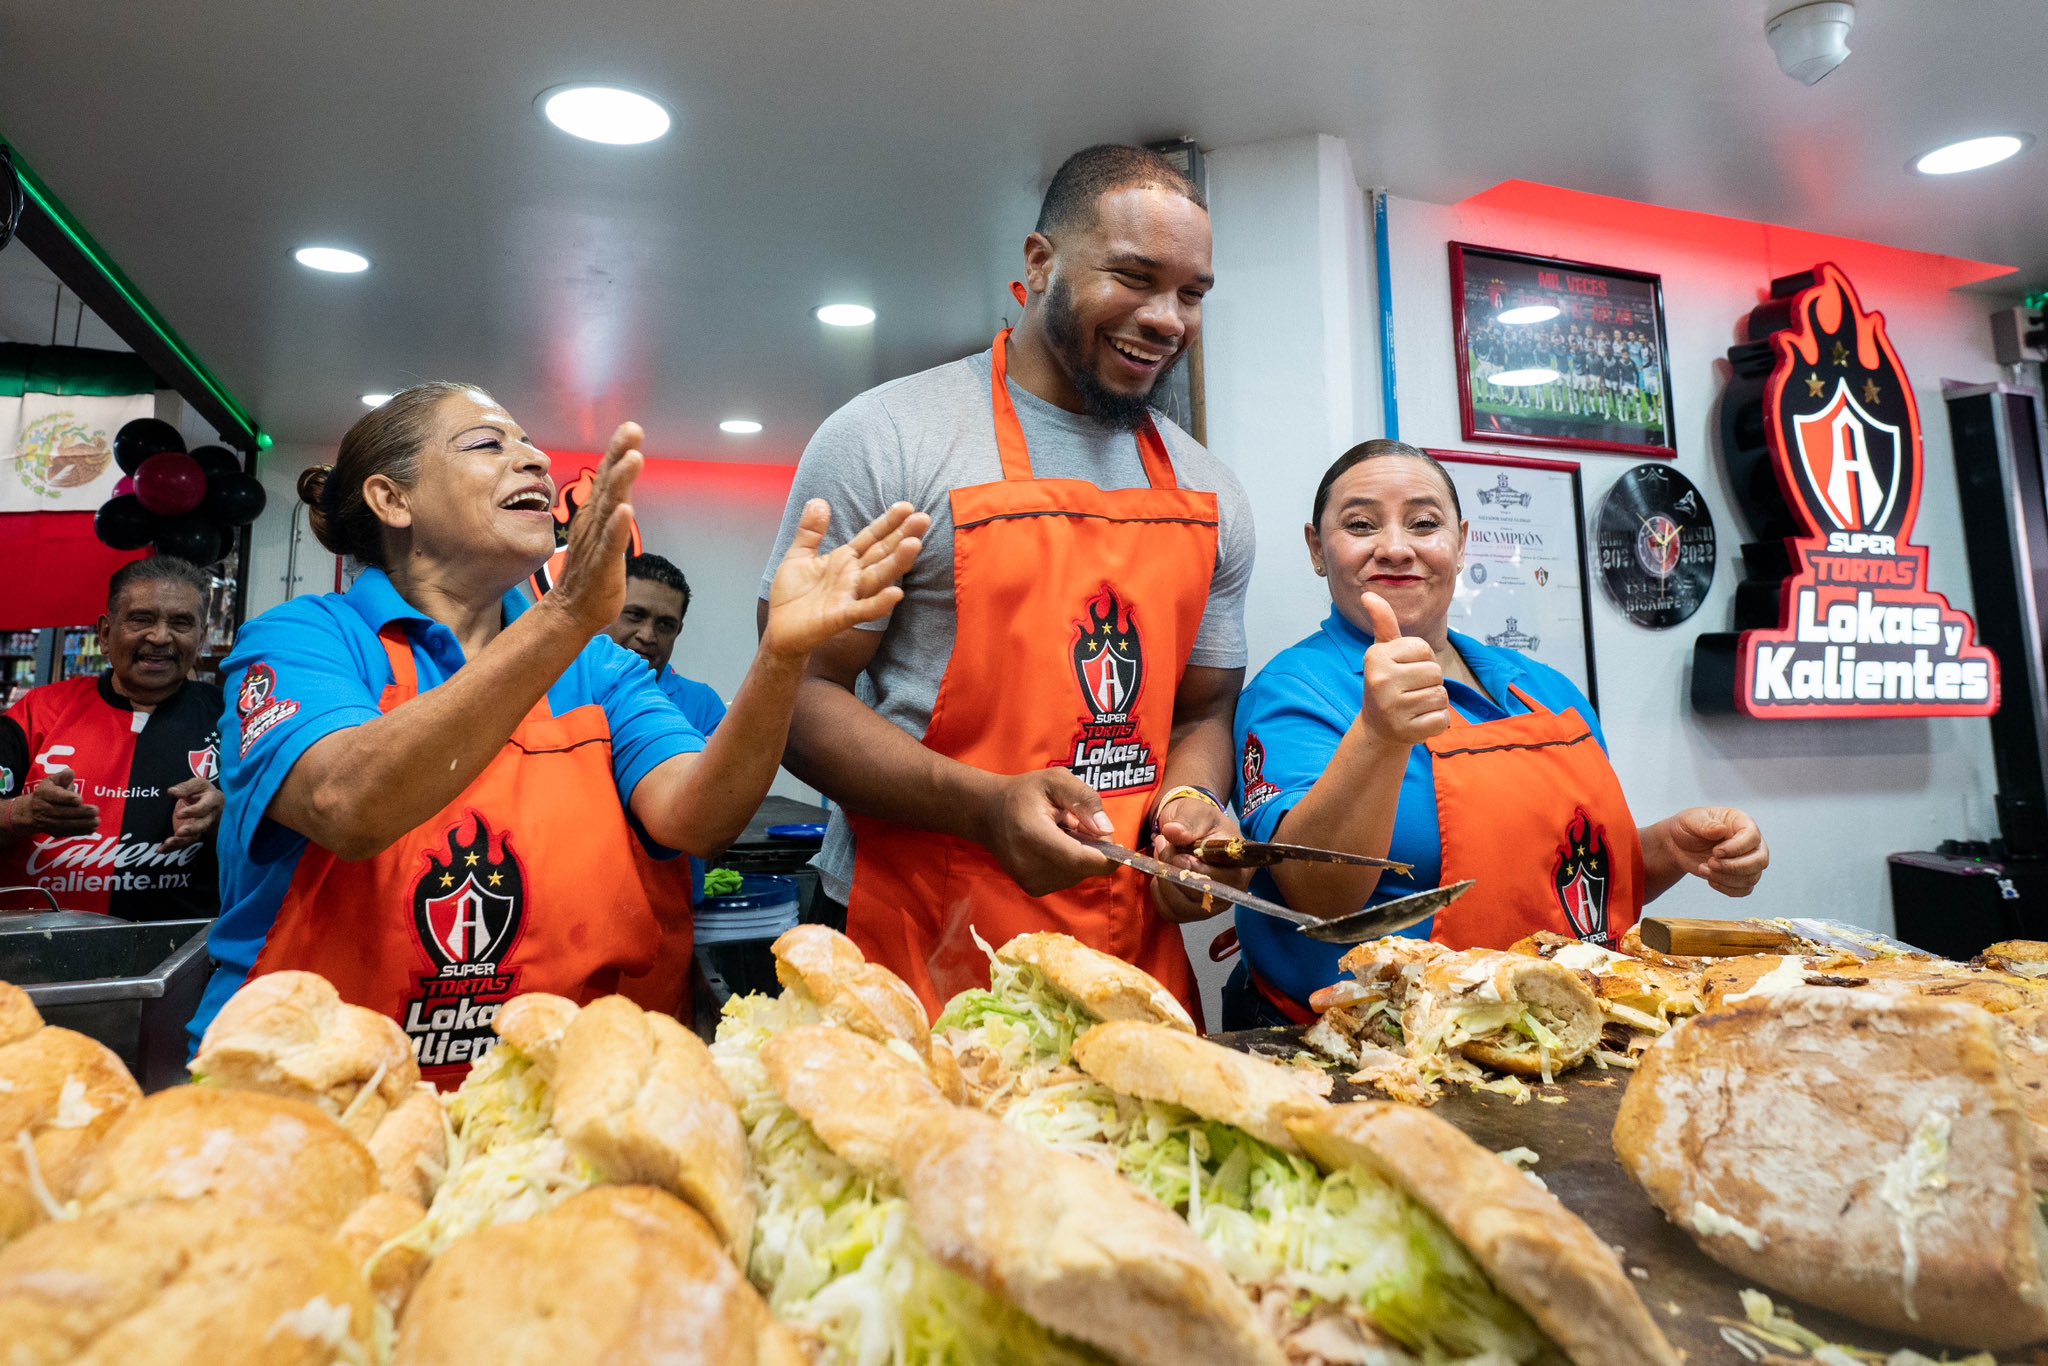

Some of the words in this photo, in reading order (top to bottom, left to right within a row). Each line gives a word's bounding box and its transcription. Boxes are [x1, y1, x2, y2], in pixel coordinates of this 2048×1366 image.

[1538, 271, 1563, 291] MIL
[1566, 275, 1608, 297] VECES
[1471, 530, 1544, 547] BICAMPEÓN
[1827, 533, 1896, 556] SUPER
[1602, 547, 1634, 570] 202
[1681, 543, 1714, 564] 2022
[1810, 556, 1917, 585] TORTAS
[1626, 596, 1692, 613] BICAMPE
[1798, 589, 1941, 644] Lokas
[1942, 625, 1963, 656] y
[1754, 645, 1990, 701] Kalientes
[1095, 713, 1127, 724] SUPER
[1075, 740, 1141, 767] Lokas
[1139, 749, 1149, 764] y
[1070, 763, 1157, 791] lientes
[94, 785, 160, 799] Uniclick
[37, 870, 192, 893] caliente.mx
[439, 962, 496, 978] SUPER
[423, 976, 511, 995] TORTAS
[405, 998, 502, 1033] Loka
